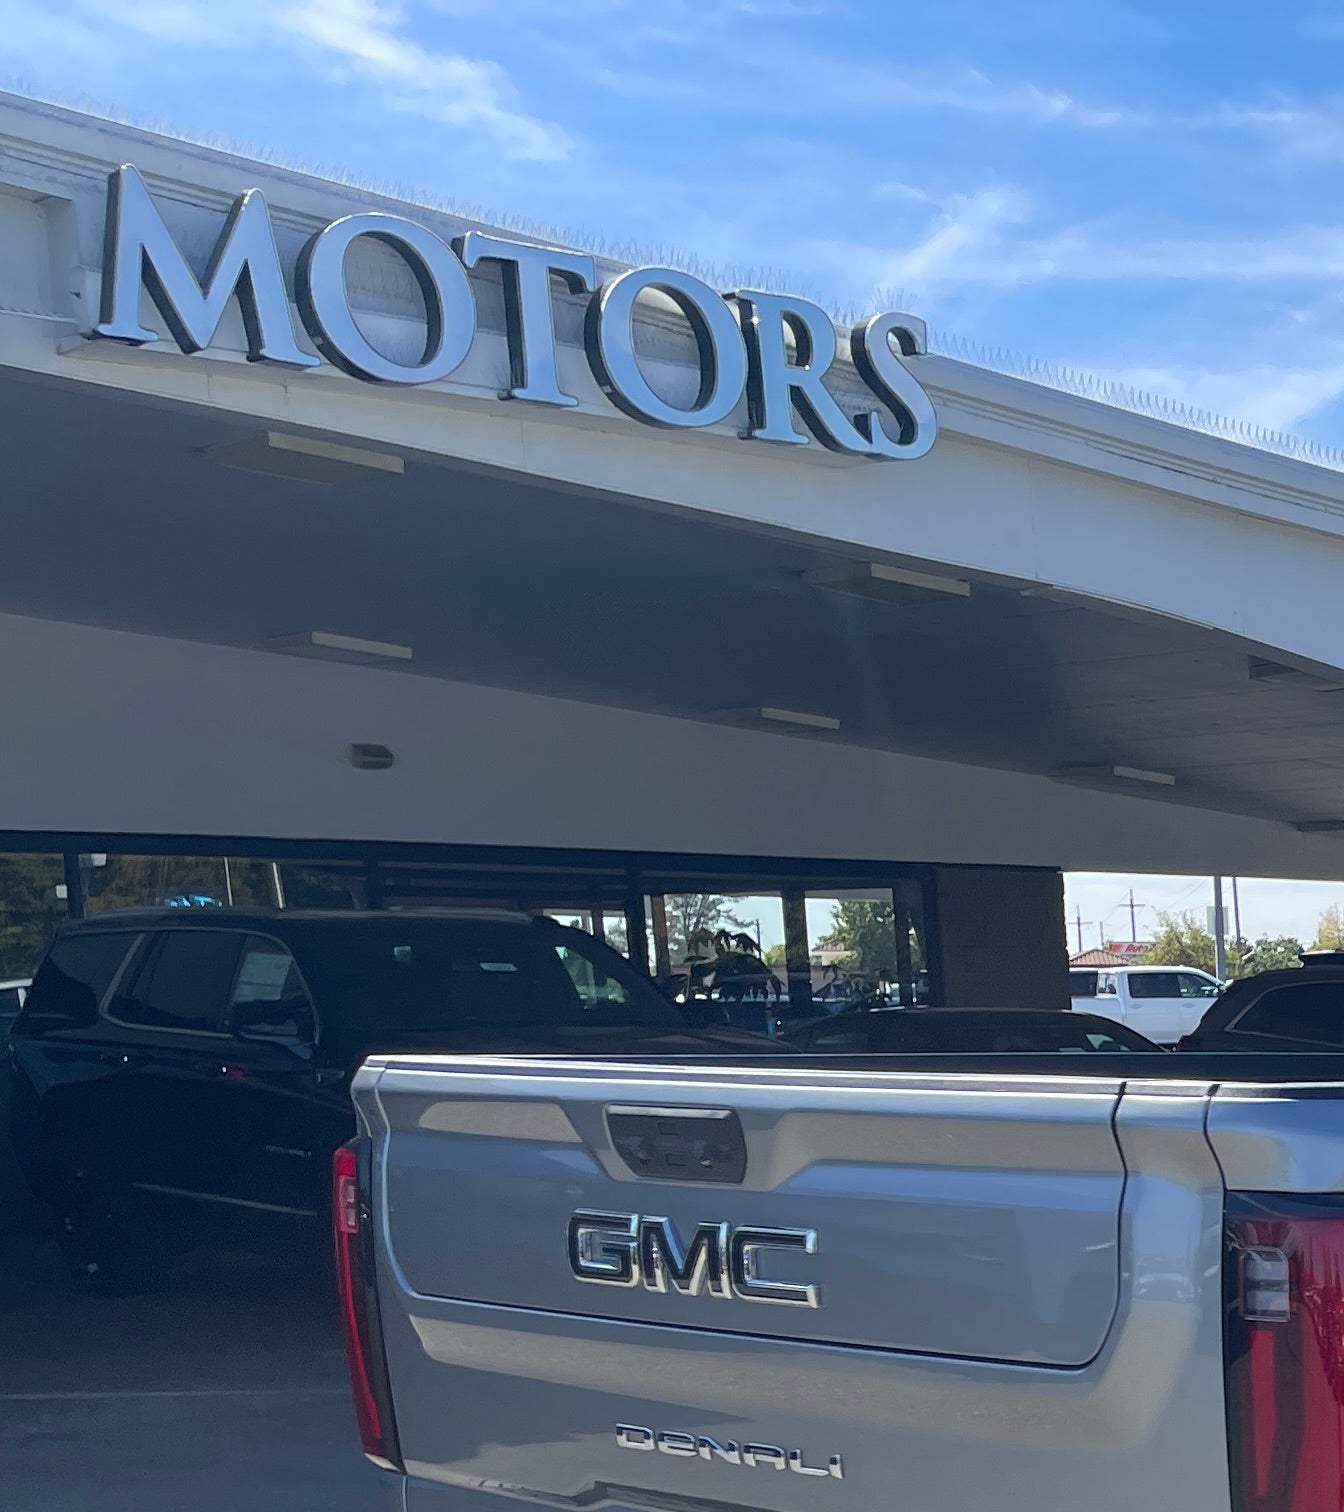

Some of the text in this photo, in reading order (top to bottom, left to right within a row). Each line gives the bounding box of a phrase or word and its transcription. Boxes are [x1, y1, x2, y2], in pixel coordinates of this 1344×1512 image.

[90, 162, 938, 461] MOTORS
[566, 1207, 820, 1309] GMC
[615, 1422, 844, 1480] DENALI
